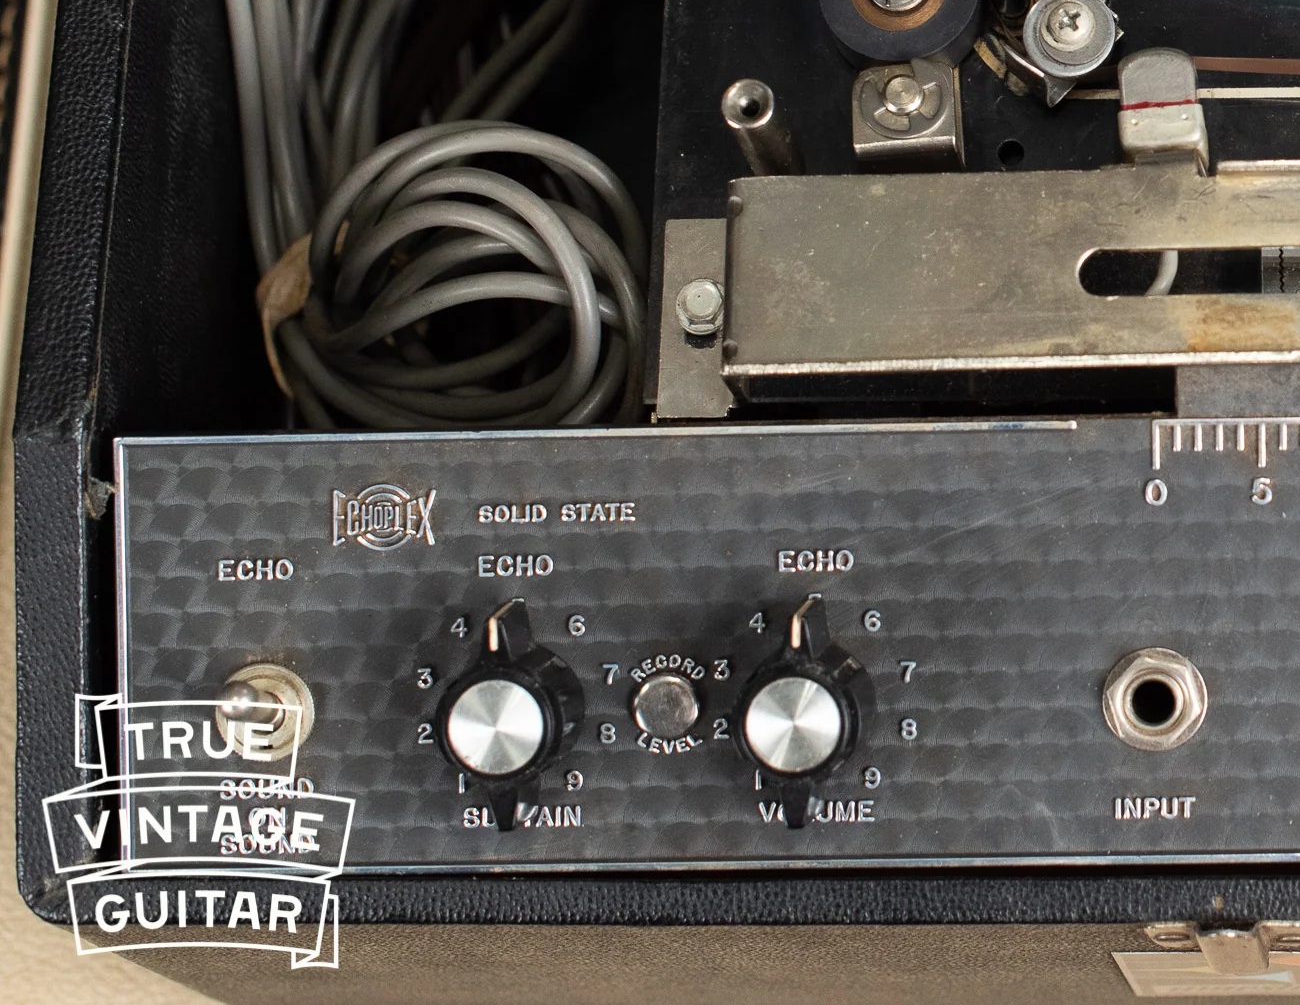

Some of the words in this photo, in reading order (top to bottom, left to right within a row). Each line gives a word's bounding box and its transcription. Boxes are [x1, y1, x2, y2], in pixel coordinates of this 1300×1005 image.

[1144, 478, 1169, 507] 0
[1251, 477, 1274, 506] 5
[331, 488, 438, 547] ECHOPLEX
[478, 503, 548, 524] SOLID
[560, 501, 637, 523] STATE
[217, 558, 295, 582] ECHO
[477, 553, 555, 578] ECHO
[777, 548, 855, 573] ECHO
[450, 617, 468, 638] 4
[568, 615, 586, 636] 6
[748, 612, 766, 633] 4
[864, 610, 882, 632] 6
[416, 667, 434, 690] 3
[602, 663, 620, 685] 7
[630, 654, 706, 683] RECORD
[713, 659, 731, 681] 3
[899, 660, 917, 684] 7
[416, 724, 435, 745] 2
[599, 724, 617, 745] 8
[712, 718, 730, 740] 2
[900, 718, 918, 740] 8
[636, 732, 703, 755] LEVEL
[565, 769, 584, 792] 9
[863, 766, 882, 789] 9
[462, 804, 582, 829] SUAIN
[758, 799, 876, 824] VUME
[1114, 797, 1197, 820] INPUT
